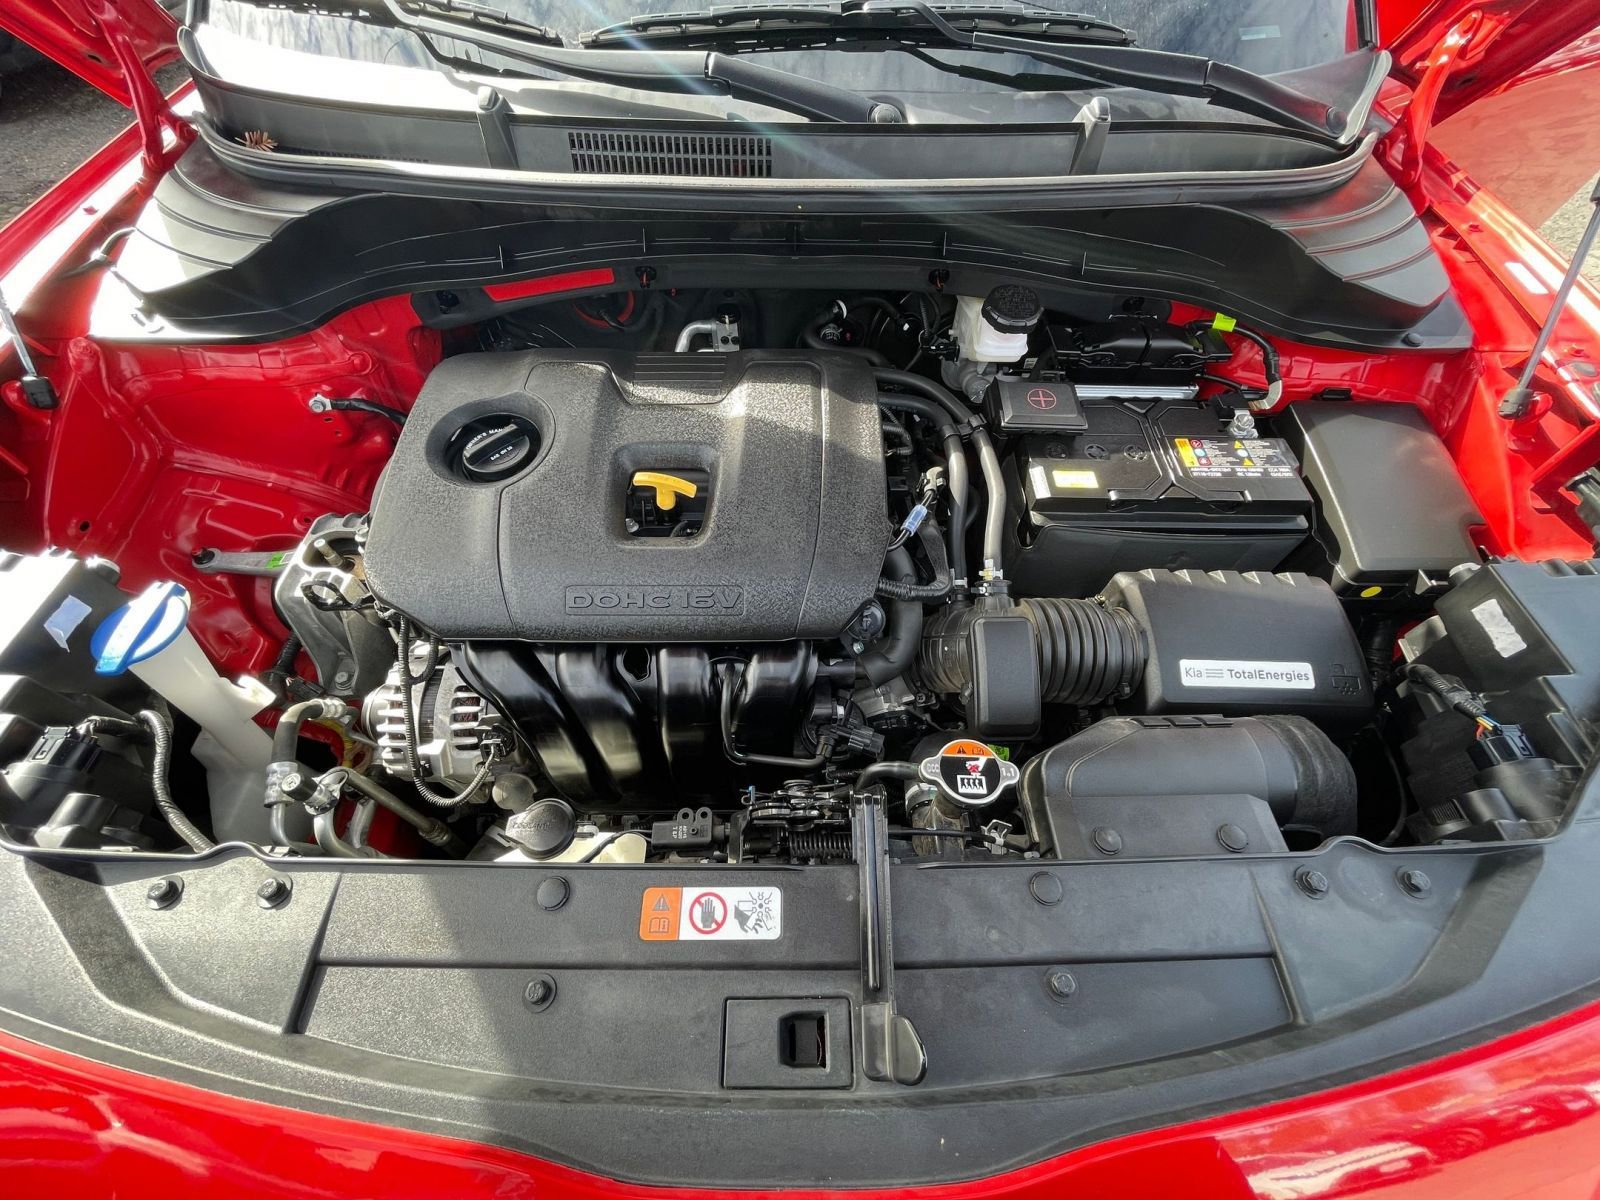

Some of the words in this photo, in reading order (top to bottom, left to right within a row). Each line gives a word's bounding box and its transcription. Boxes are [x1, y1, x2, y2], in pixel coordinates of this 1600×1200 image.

[568, 592, 671, 609] DOHC
[679, 592, 741, 609] 16V
[1185, 667, 1203, 679] Kia
[1227, 668, 1310, 682] TotalEnergies
[1002, 767, 1015, 777] 1.1
